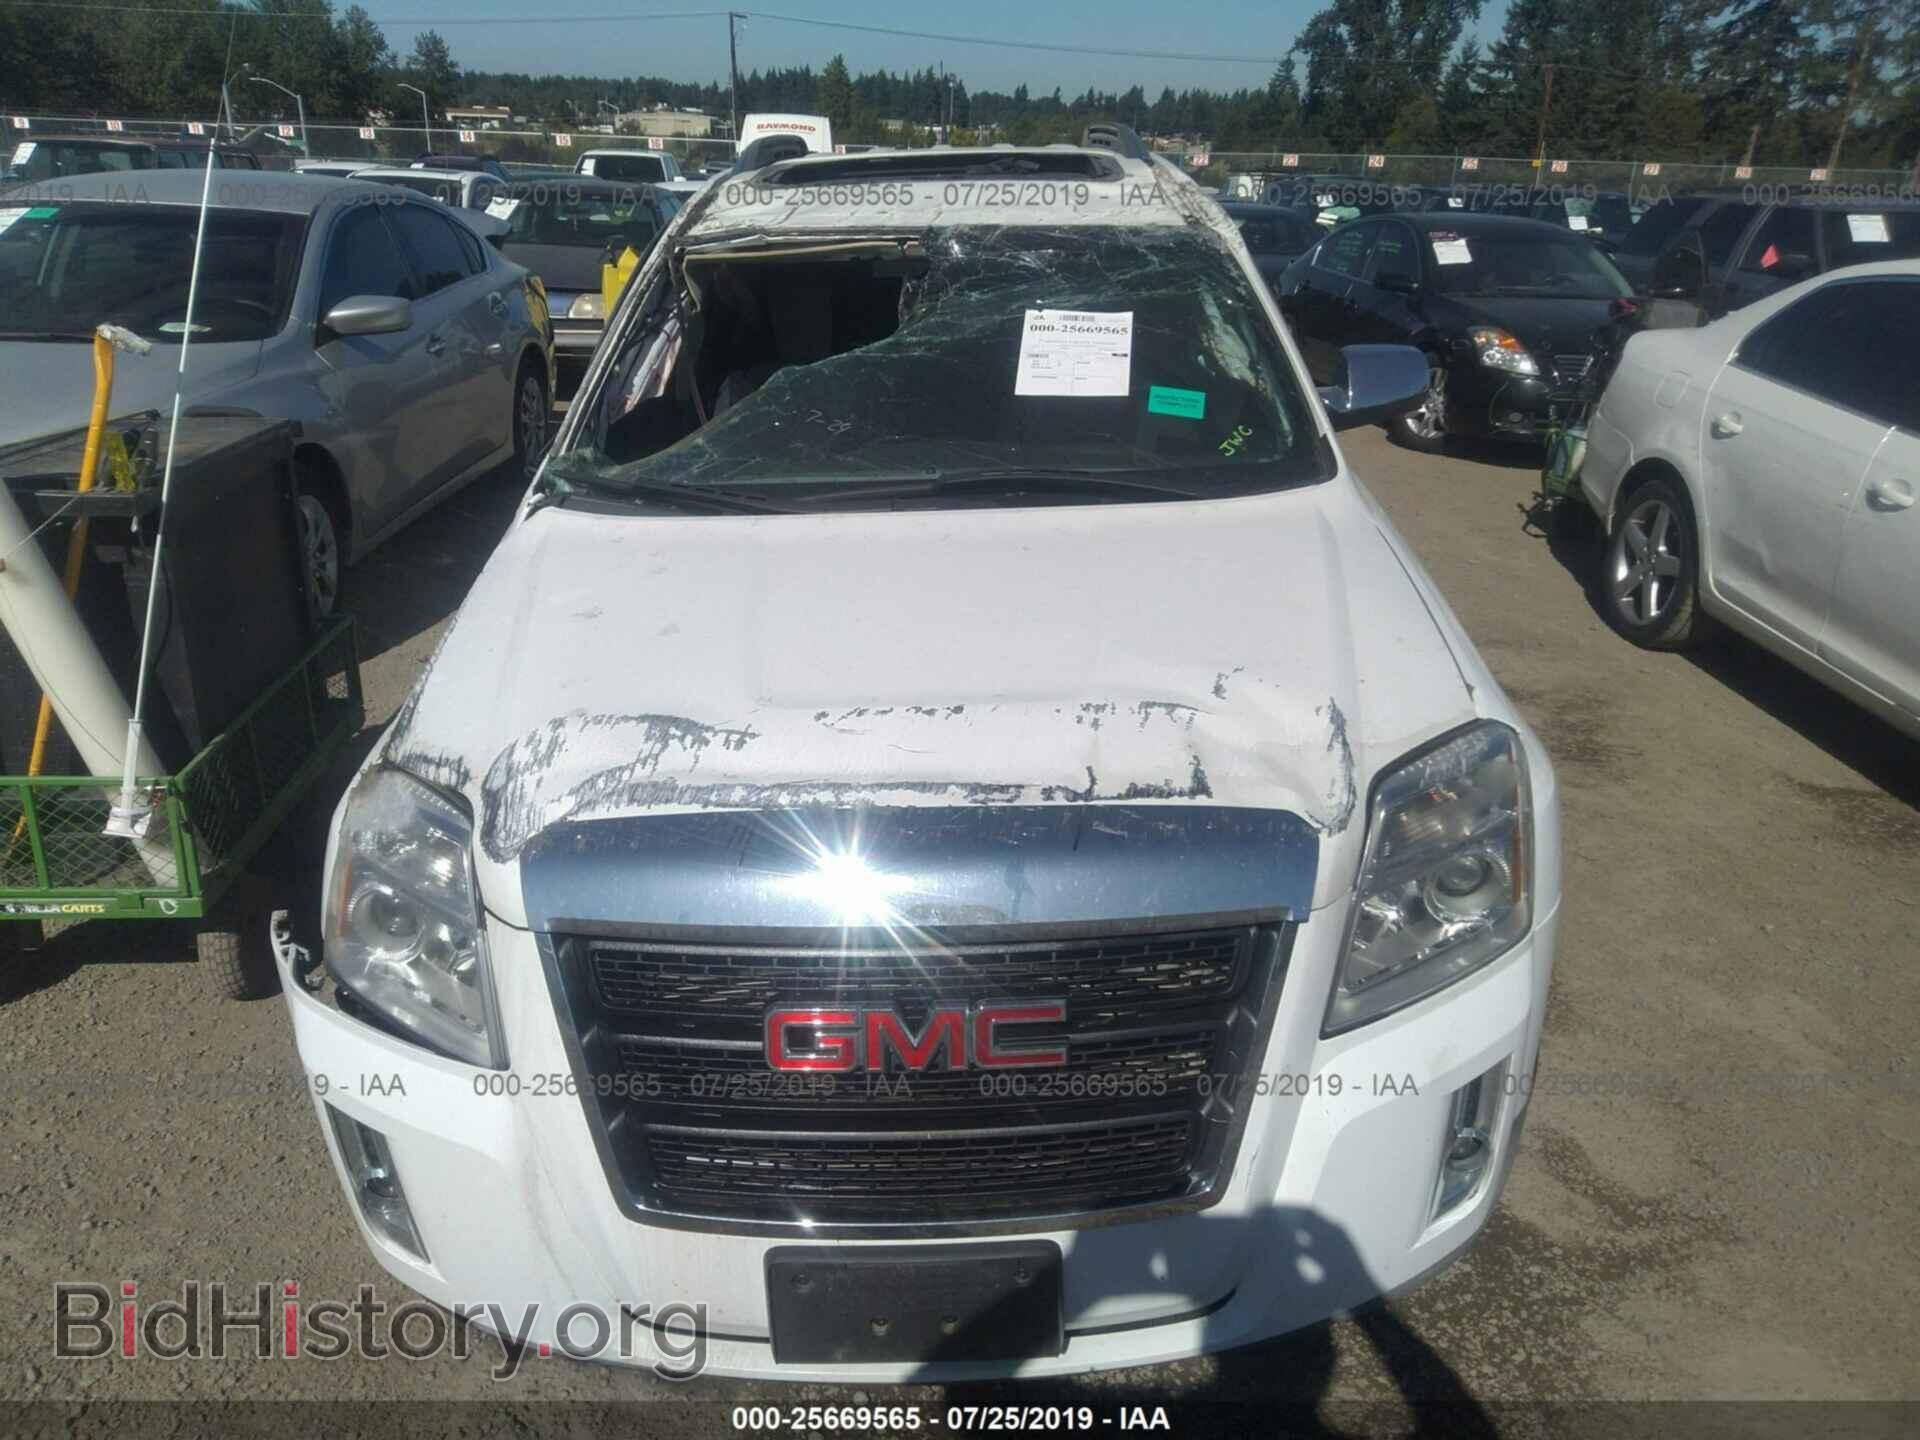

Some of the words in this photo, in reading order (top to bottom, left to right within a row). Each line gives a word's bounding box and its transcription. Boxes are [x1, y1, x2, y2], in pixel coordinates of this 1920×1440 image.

[756, 122, 816, 132] RAYMOND
[1369, 156, 1383, 167] 24
[1029, 323, 1128, 335] 000-25669565
[1219, 425, 1253, 457] JWC
[62, 904, 105, 913] CARTS
[765, 1000, 1069, 1072] GMC
